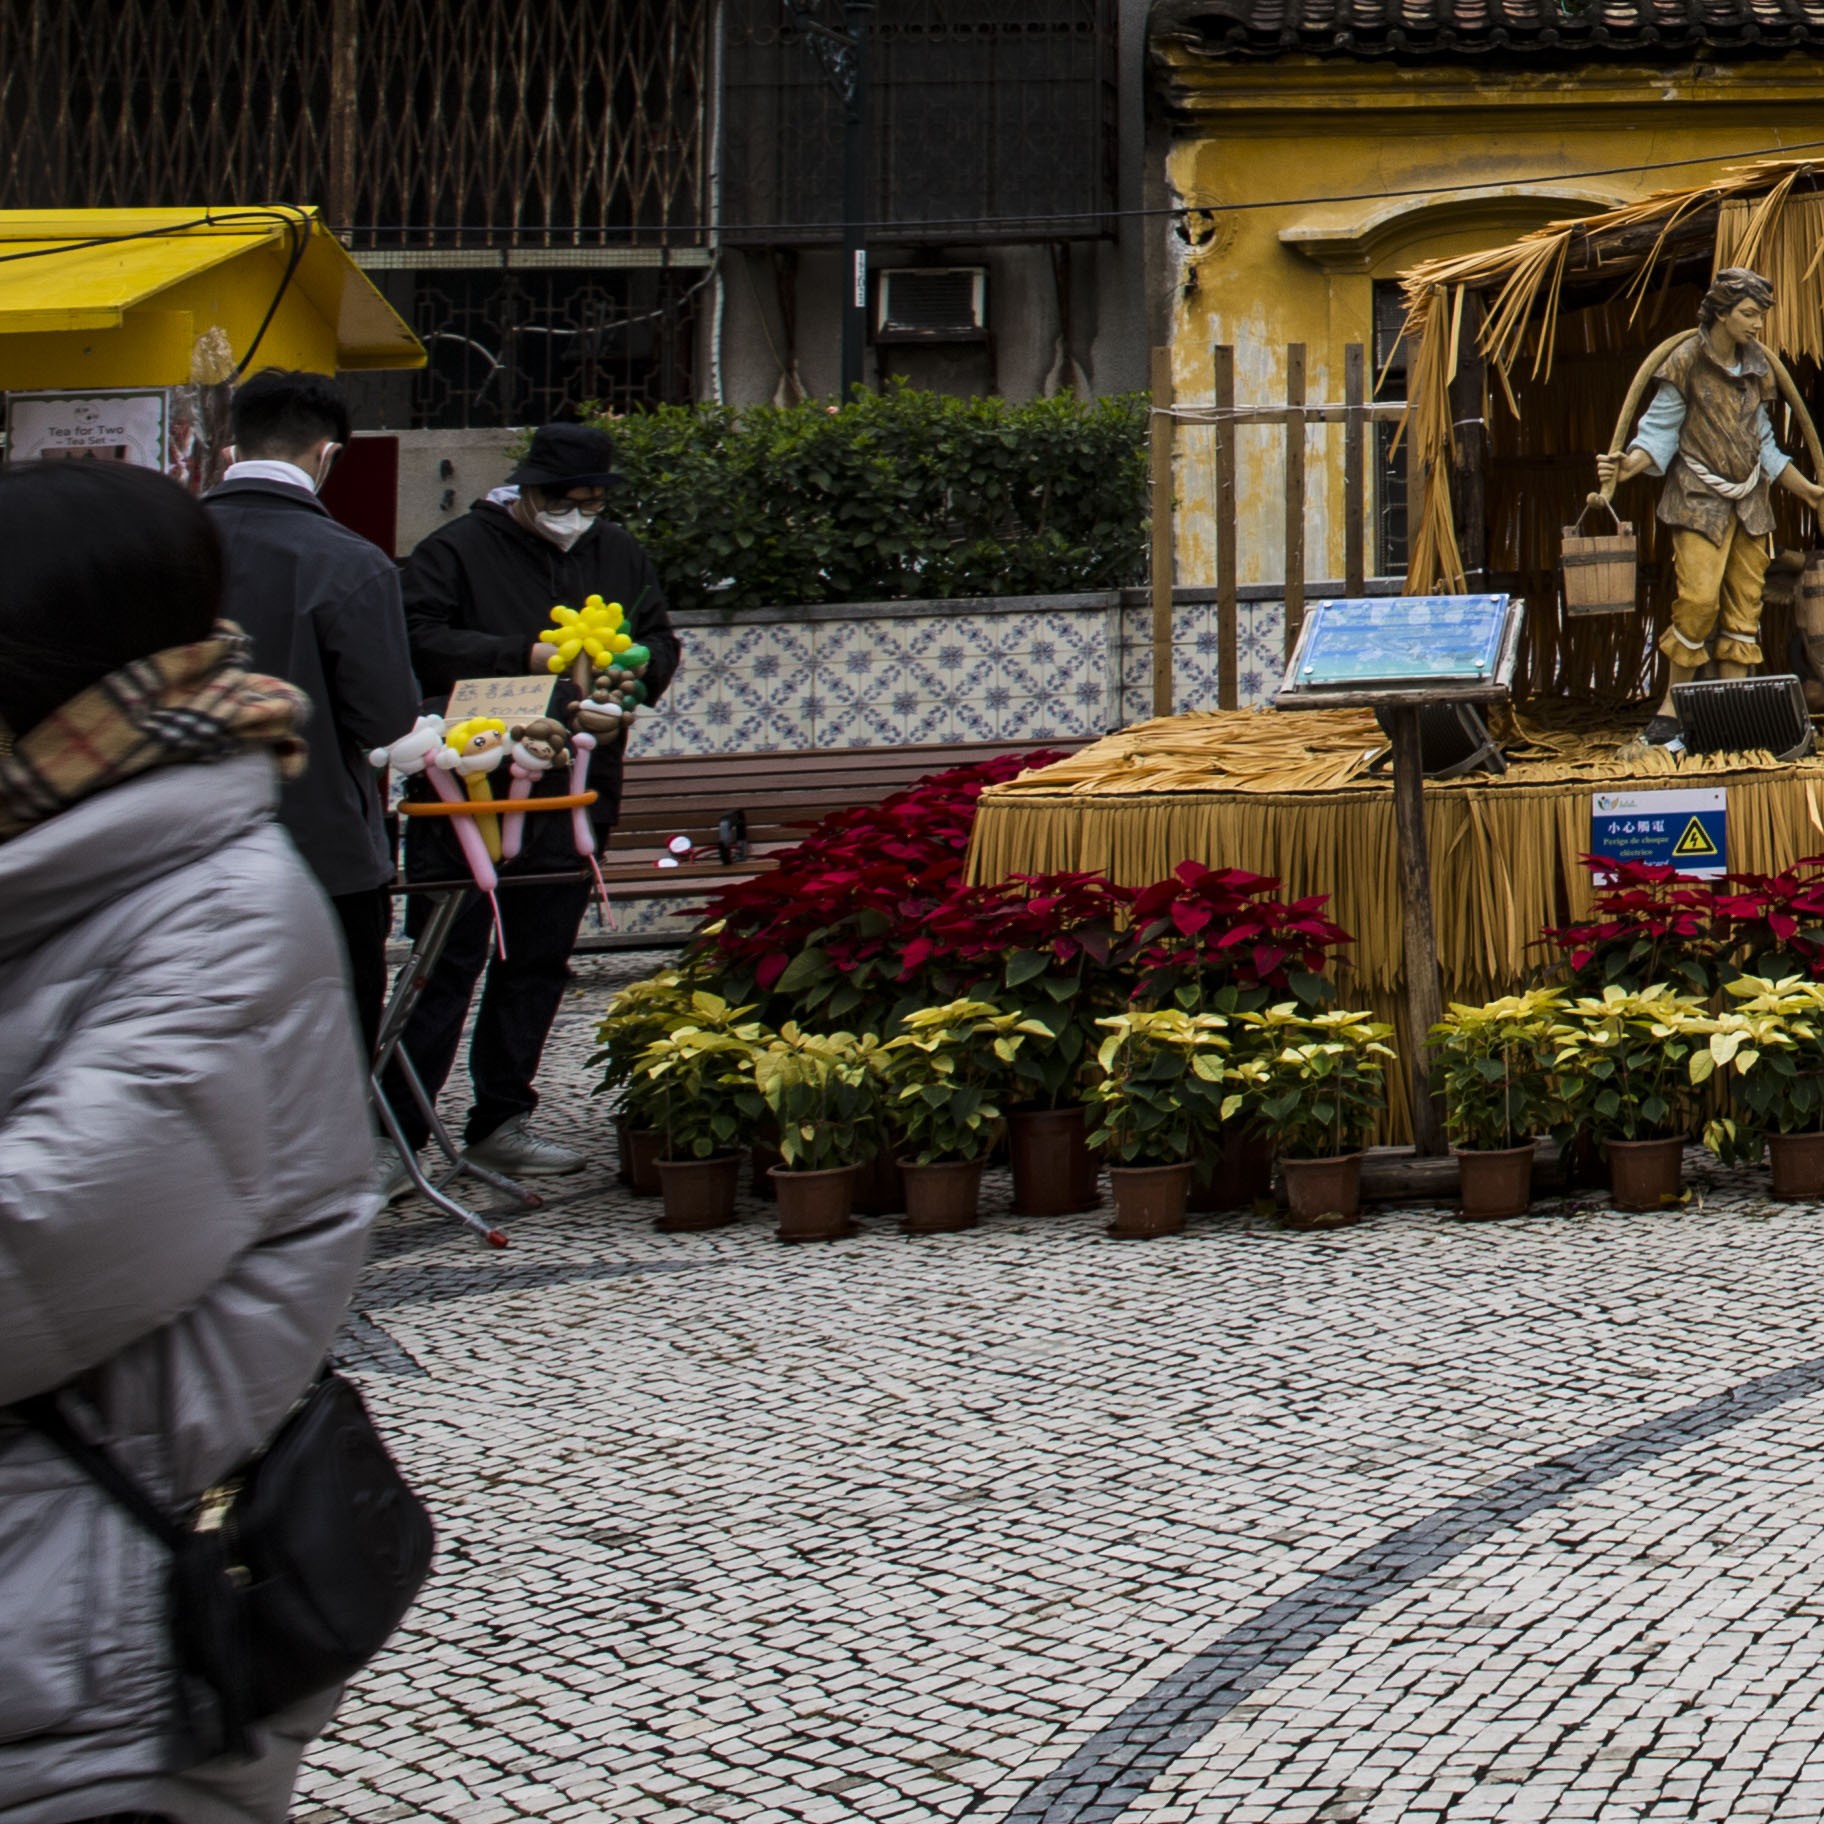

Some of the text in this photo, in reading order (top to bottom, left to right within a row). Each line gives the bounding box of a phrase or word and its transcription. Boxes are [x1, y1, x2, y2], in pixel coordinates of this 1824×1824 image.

[48, 425, 125, 437] Tea for Two
[67, 437, 106, 446] Tea Set
[1607, 819, 1665, 835] 小心觸電
[1603, 837, 1629, 847] Perigo
[1630, 836, 1640, 844] de
